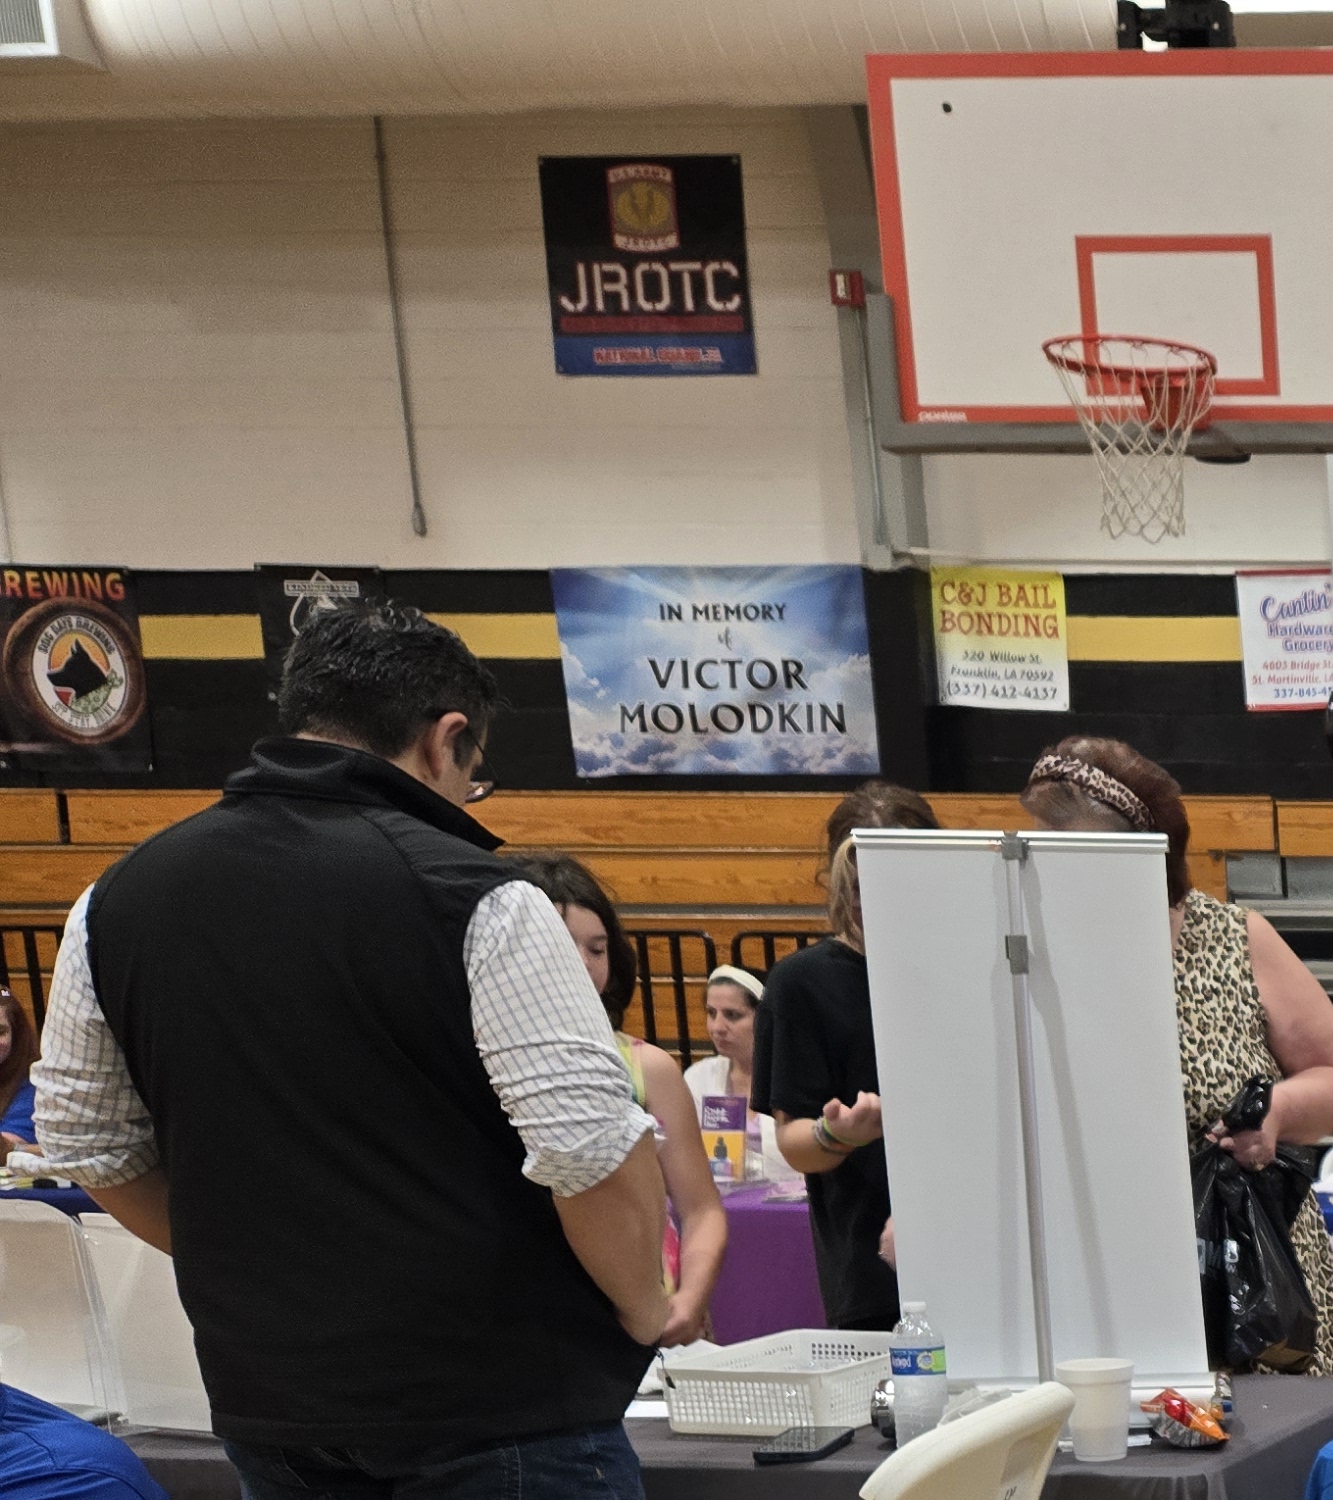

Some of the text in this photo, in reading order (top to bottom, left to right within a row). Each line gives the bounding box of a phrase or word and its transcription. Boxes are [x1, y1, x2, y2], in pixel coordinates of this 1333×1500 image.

[558, 261, 742, 312] JROTC
[0, 569, 126, 600] REWING
[940, 580, 1057, 609] C&J BAIL
[659, 602, 787, 621] IN MEMORY
[940, 610, 1059, 638] BONDING
[647, 657, 810, 690] VICTOR
[1004, 668, 1017, 680] LA
[619, 701, 847, 734] MOLODKIN
